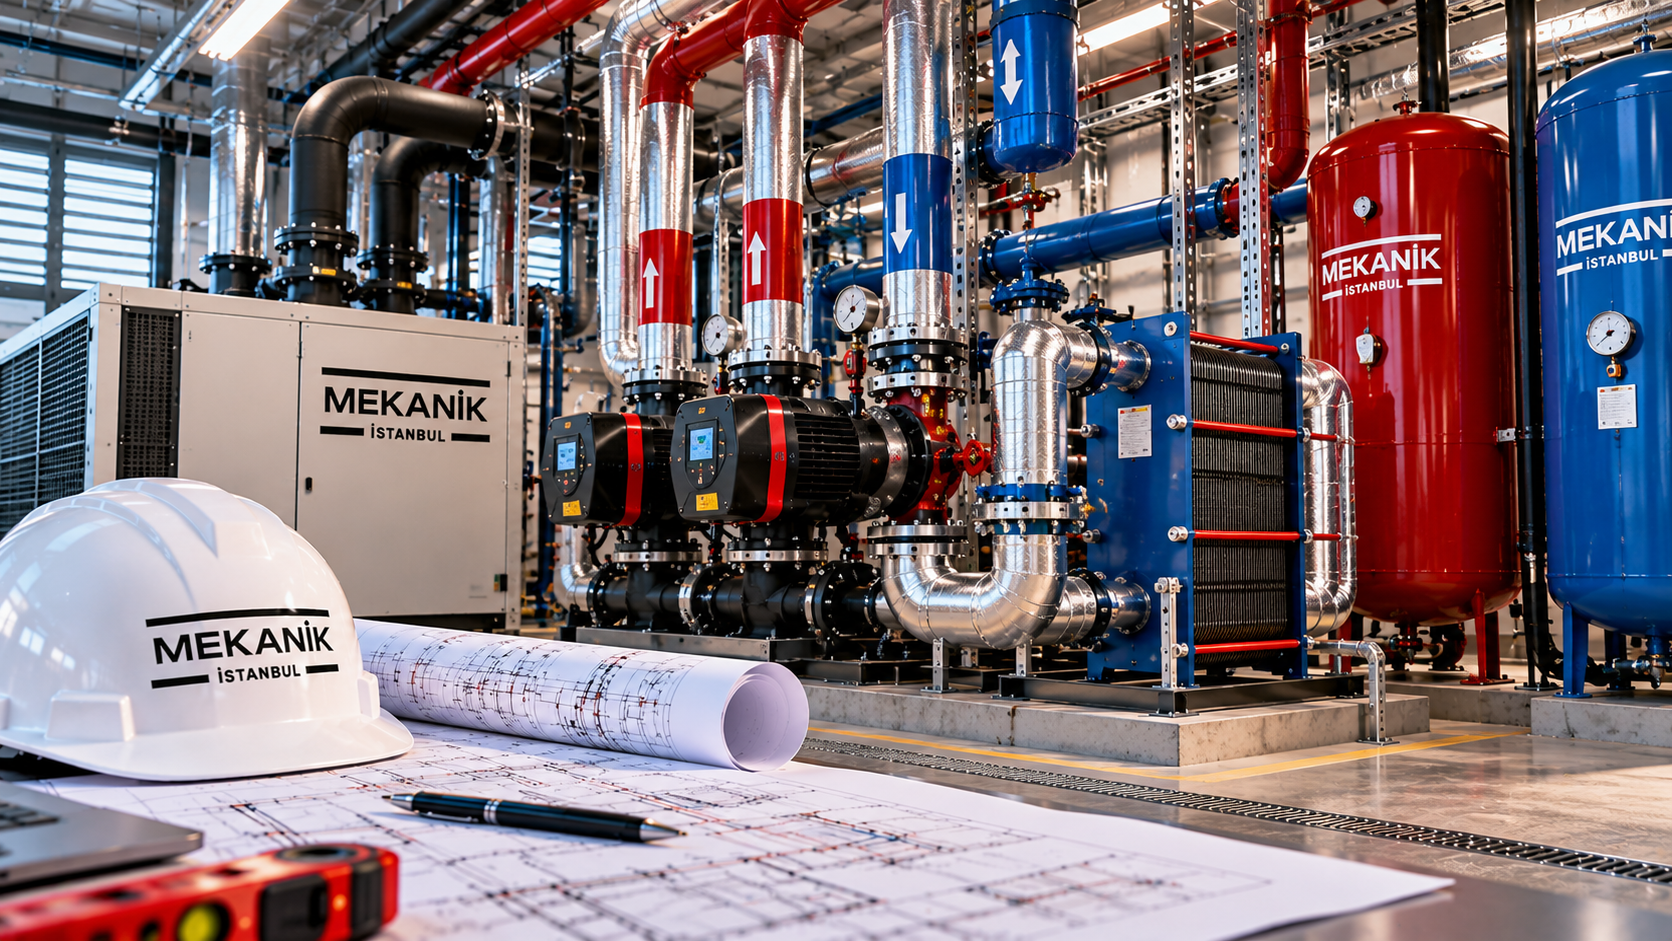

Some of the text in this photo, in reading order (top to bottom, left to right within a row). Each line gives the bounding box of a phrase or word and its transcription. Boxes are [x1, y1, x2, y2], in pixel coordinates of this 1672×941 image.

[1322, 243, 1442, 286] MEKANİK
[1586, 248, 1659, 271] İSTANBUL
[1345, 278, 1404, 297] İSTANBUL
[324, 386, 488, 423] MEKANİK
[370, 423, 446, 443] İSTANBUL
[153, 619, 334, 665] MEKANİK
[217, 664, 301, 684] İSTANBUL
